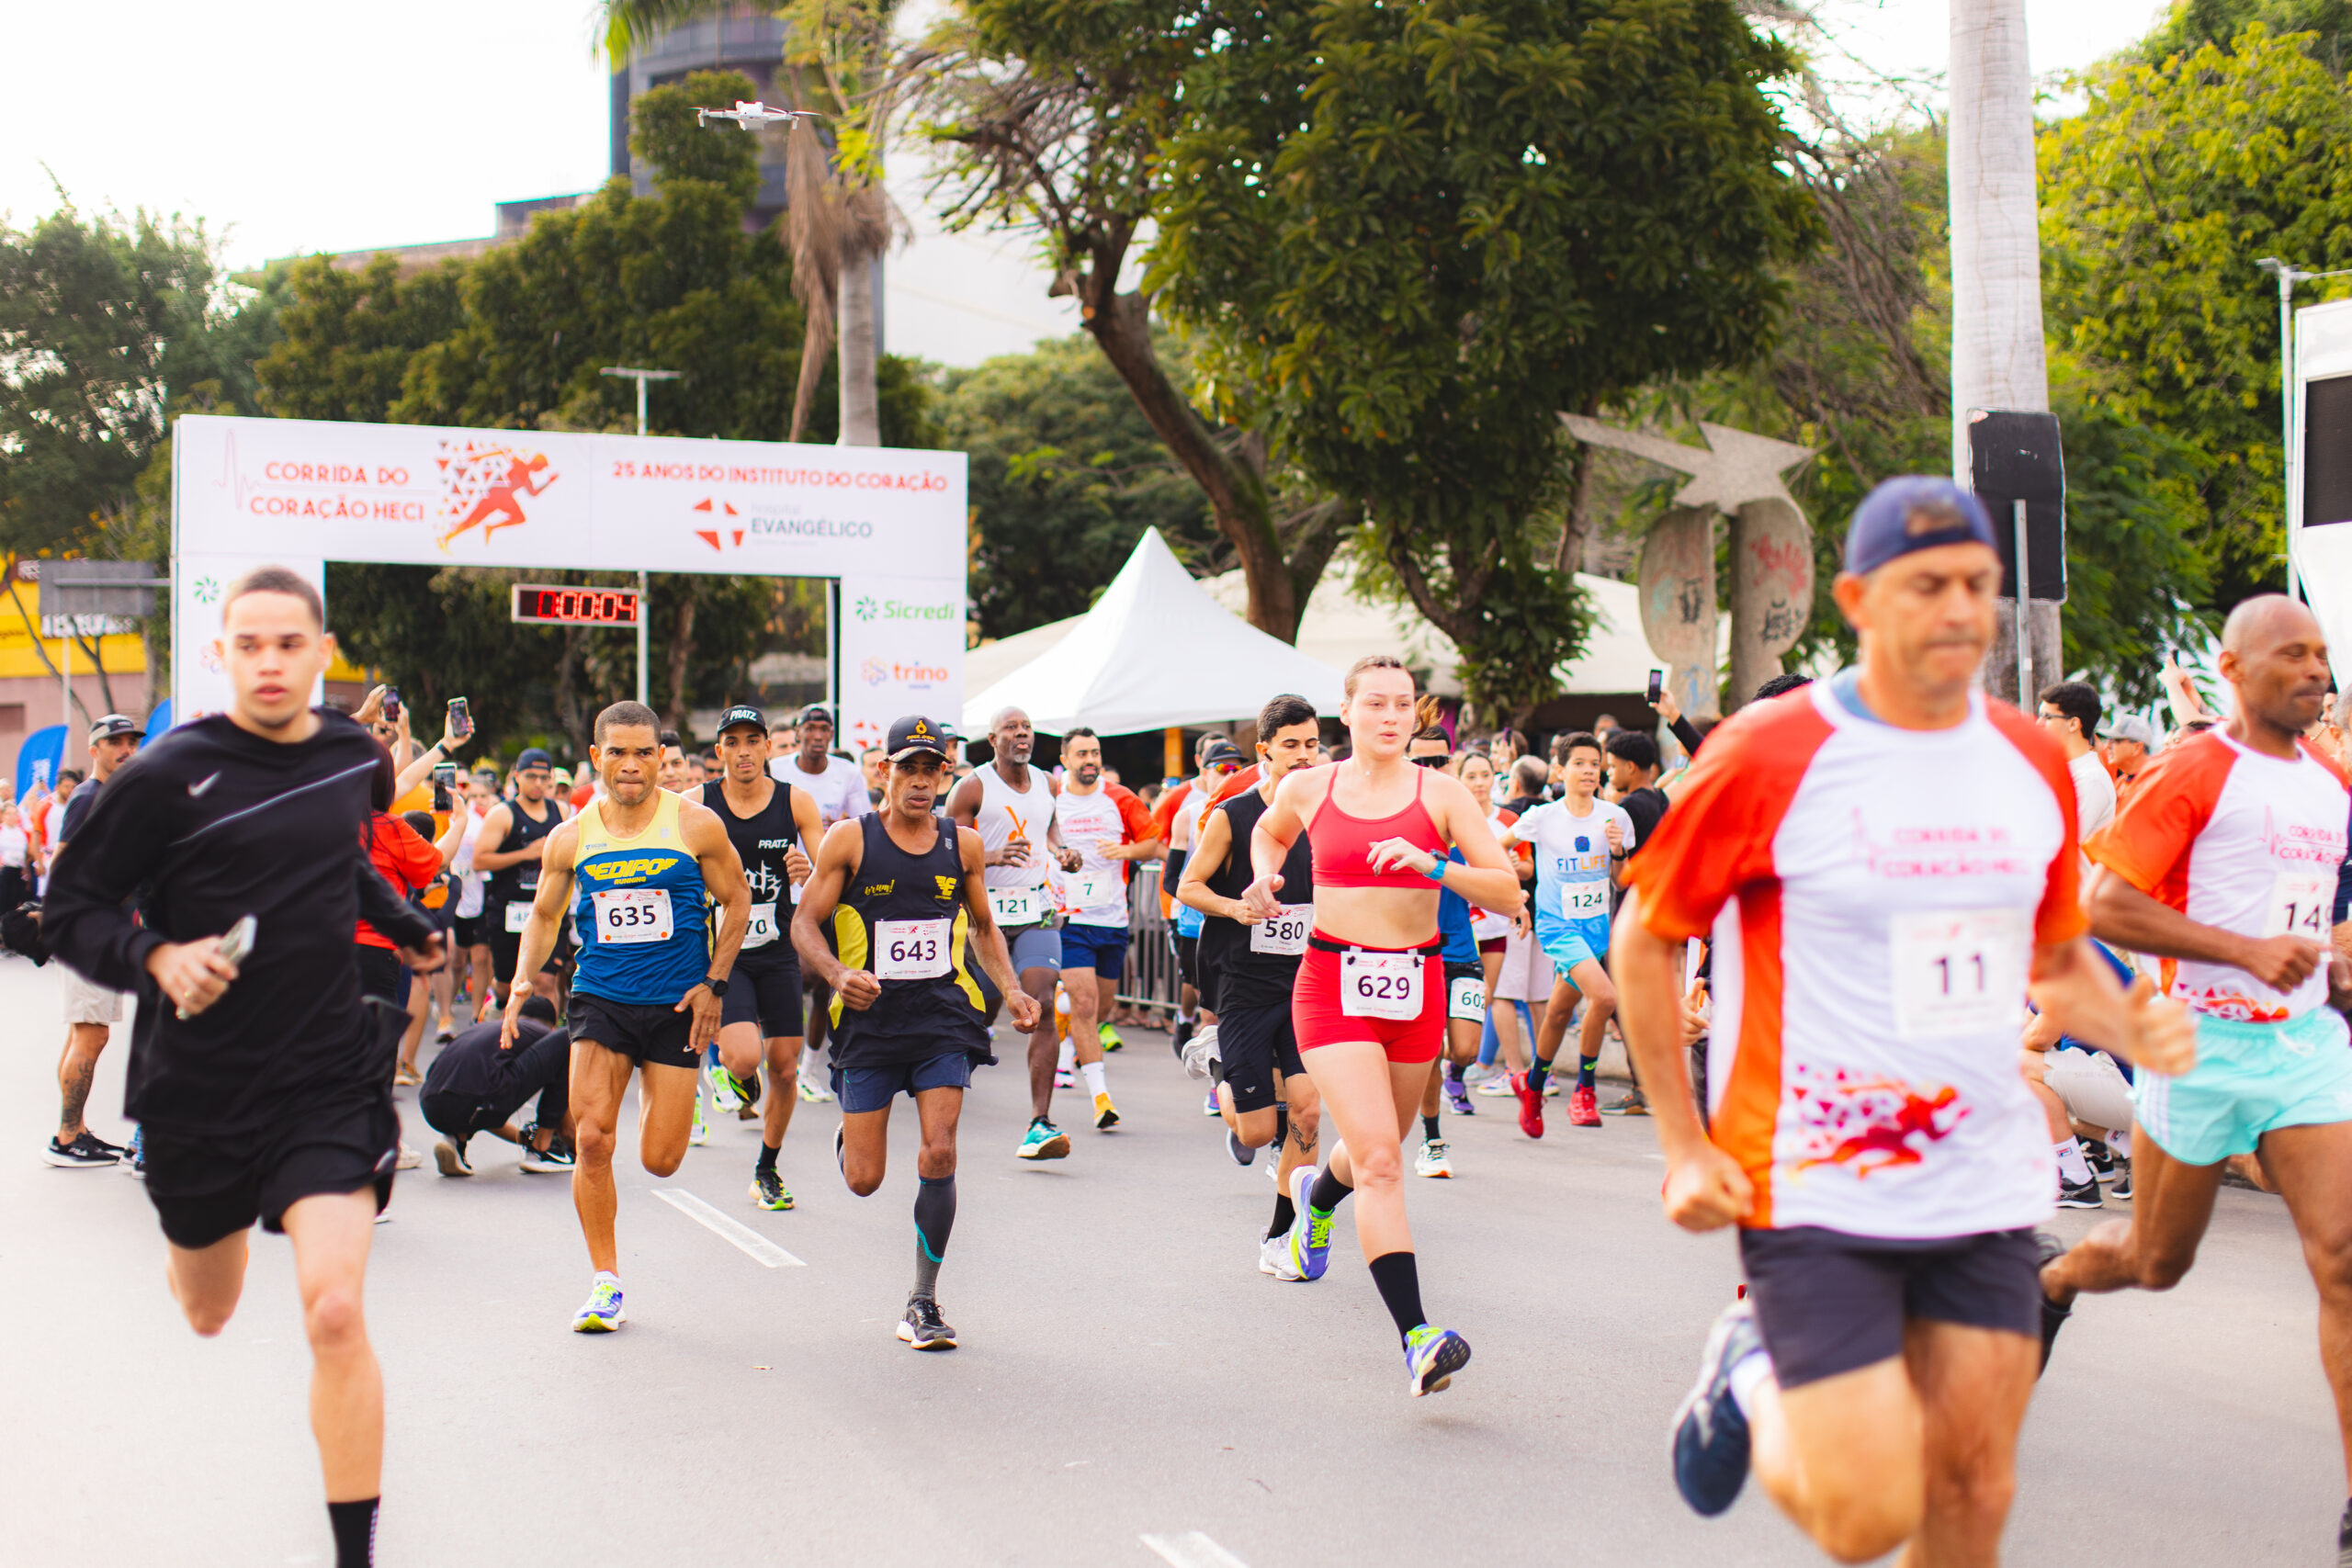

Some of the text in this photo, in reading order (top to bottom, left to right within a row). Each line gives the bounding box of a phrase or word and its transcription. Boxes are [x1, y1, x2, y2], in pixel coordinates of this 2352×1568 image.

[266, 462, 409, 485] CORRIDA DO
[614, 461, 948, 492] 25 ANOS DO INSTITUTO DO CORAÇÃO
[250, 494, 424, 521] CORAÇÃO HECI
[752, 514, 873, 538] EVANGÉLICO
[883, 600, 955, 620] Sicredi
[894, 661, 948, 682] trino
[729, 709, 757, 721] PRATZ
[758, 839, 788, 849] PRATZ
[590, 858, 671, 881] EDIPO
[1557, 855, 1607, 872] FIT LIFE
[1083, 883, 1093, 897] 7
[1572, 892, 1602, 908] 124
[609, 904, 656, 928] 635
[996, 898, 1028, 913] 121
[1264, 919, 1304, 941] 580
[890, 940, 937, 963] 643
[1931, 951, 1985, 996] 11
[1358, 975, 1410, 1000] 629
